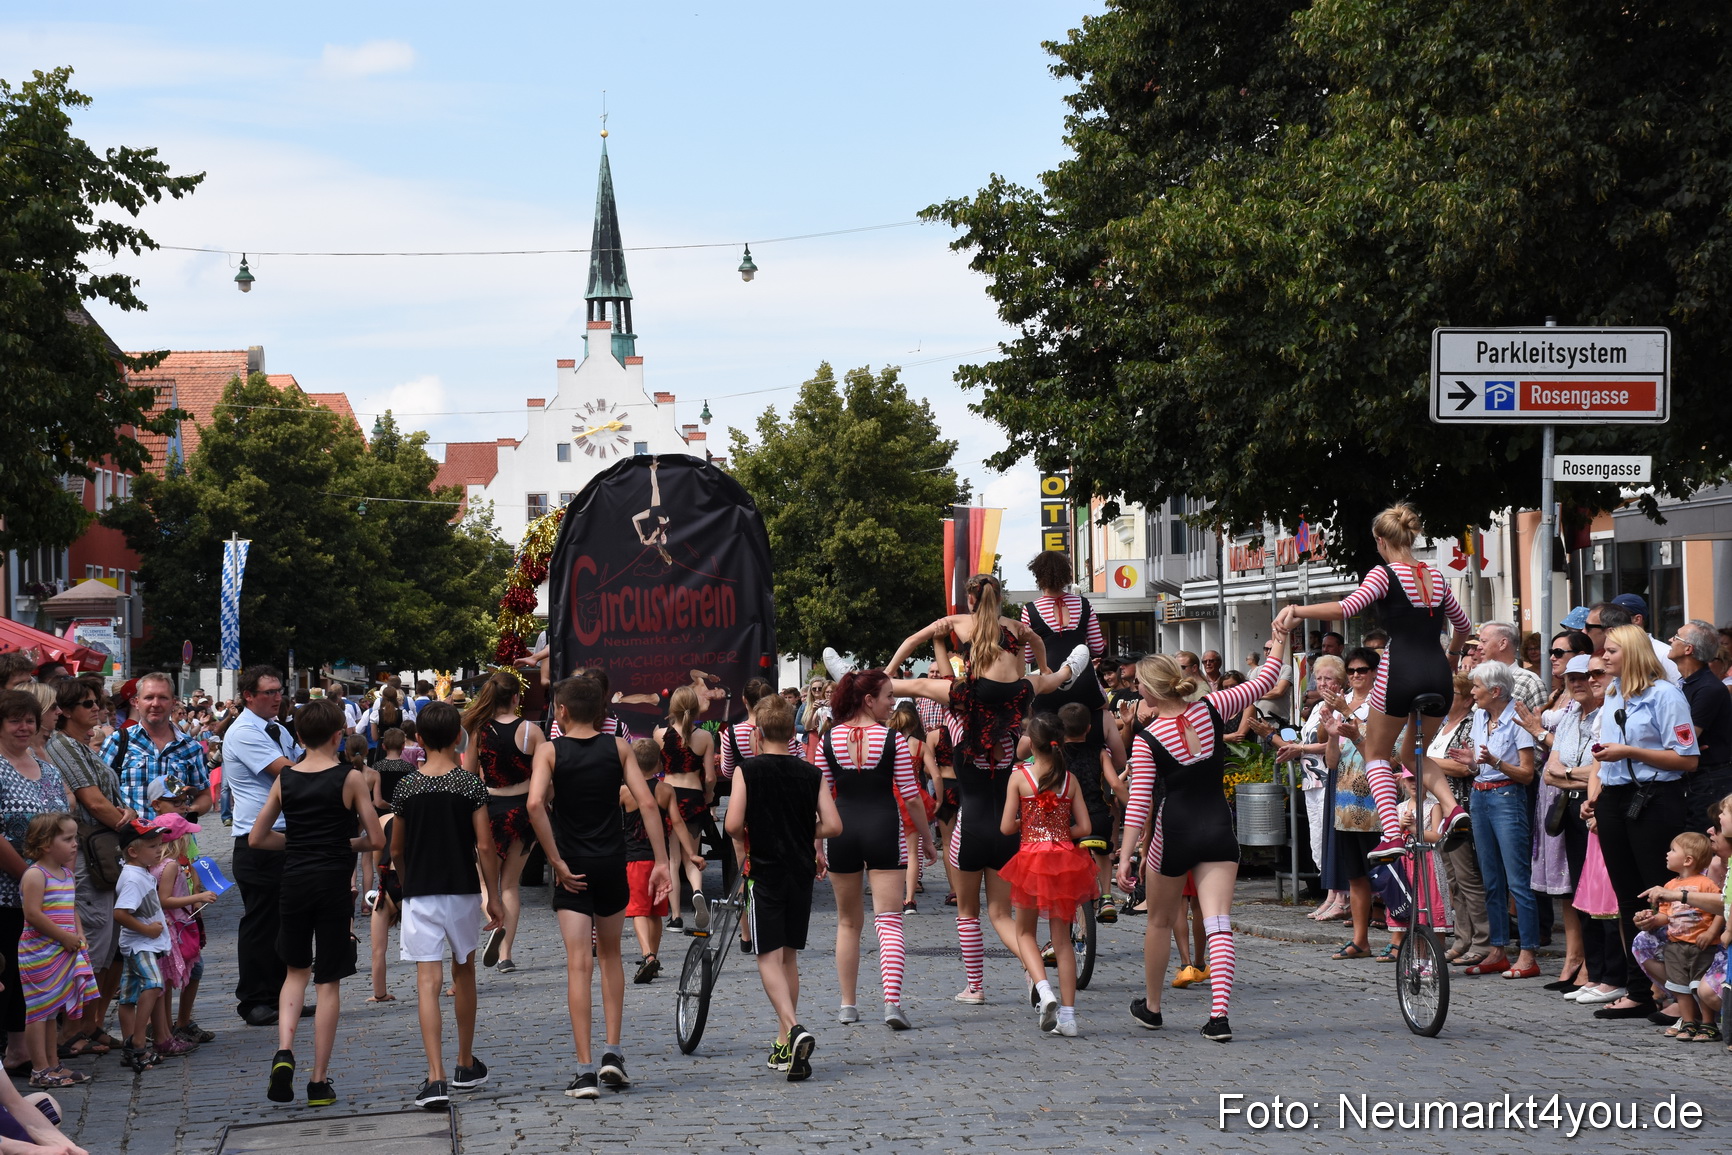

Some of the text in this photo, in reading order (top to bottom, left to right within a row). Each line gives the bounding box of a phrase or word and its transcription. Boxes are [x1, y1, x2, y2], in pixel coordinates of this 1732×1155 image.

[1476, 340, 1627, 369] Parkleitsystem
[1494, 385, 1629, 409] P Rosengasse
[1562, 460, 1641, 479] Rosengasse
[1041, 476, 1066, 552] OTE
[570, 554, 736, 647] Circusverein
[603, 635, 668, 647] Neumarkt
[609, 654, 675, 669] MACHEN
[629, 671, 687, 687] STARK
